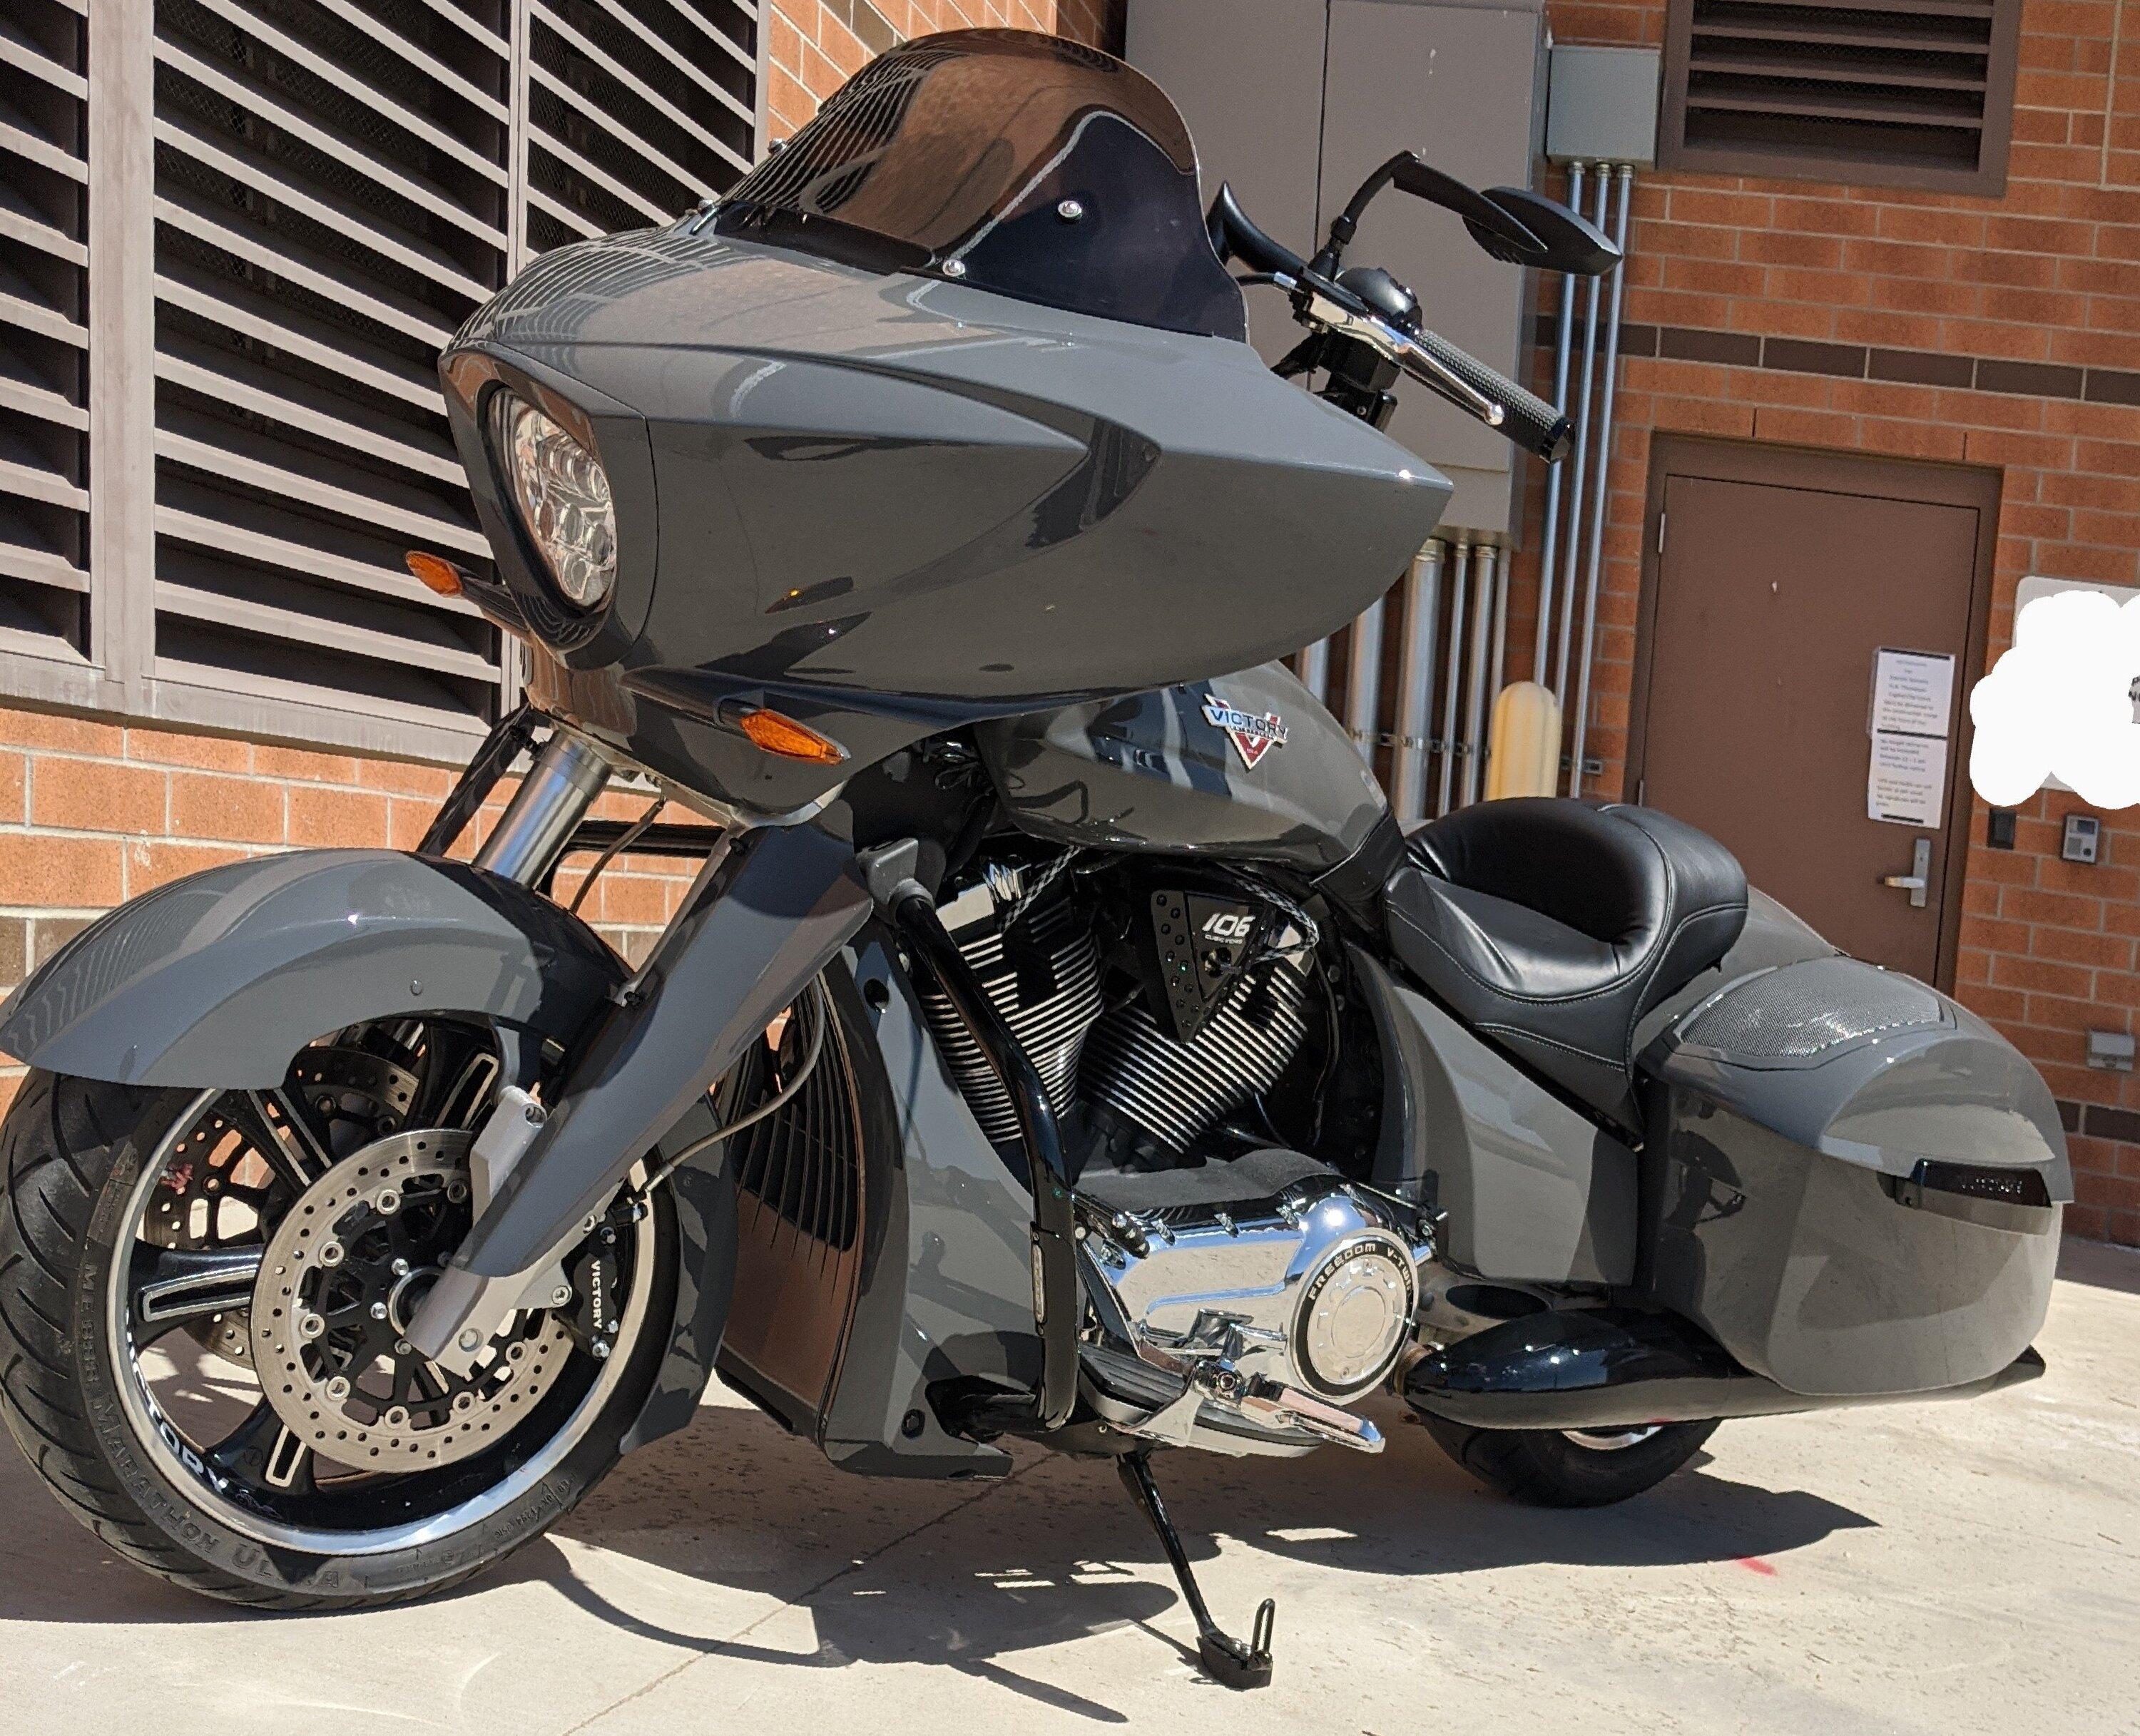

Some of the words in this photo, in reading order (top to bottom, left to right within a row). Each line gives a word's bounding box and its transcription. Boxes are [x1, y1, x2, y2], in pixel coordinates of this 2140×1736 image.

[1210, 709, 1286, 739] VICTORY
[1202, 913, 1255, 937] 106
[1308, 1242, 1376, 1300] FREEDOM
[591, 1260, 602, 1329] VICTORY
